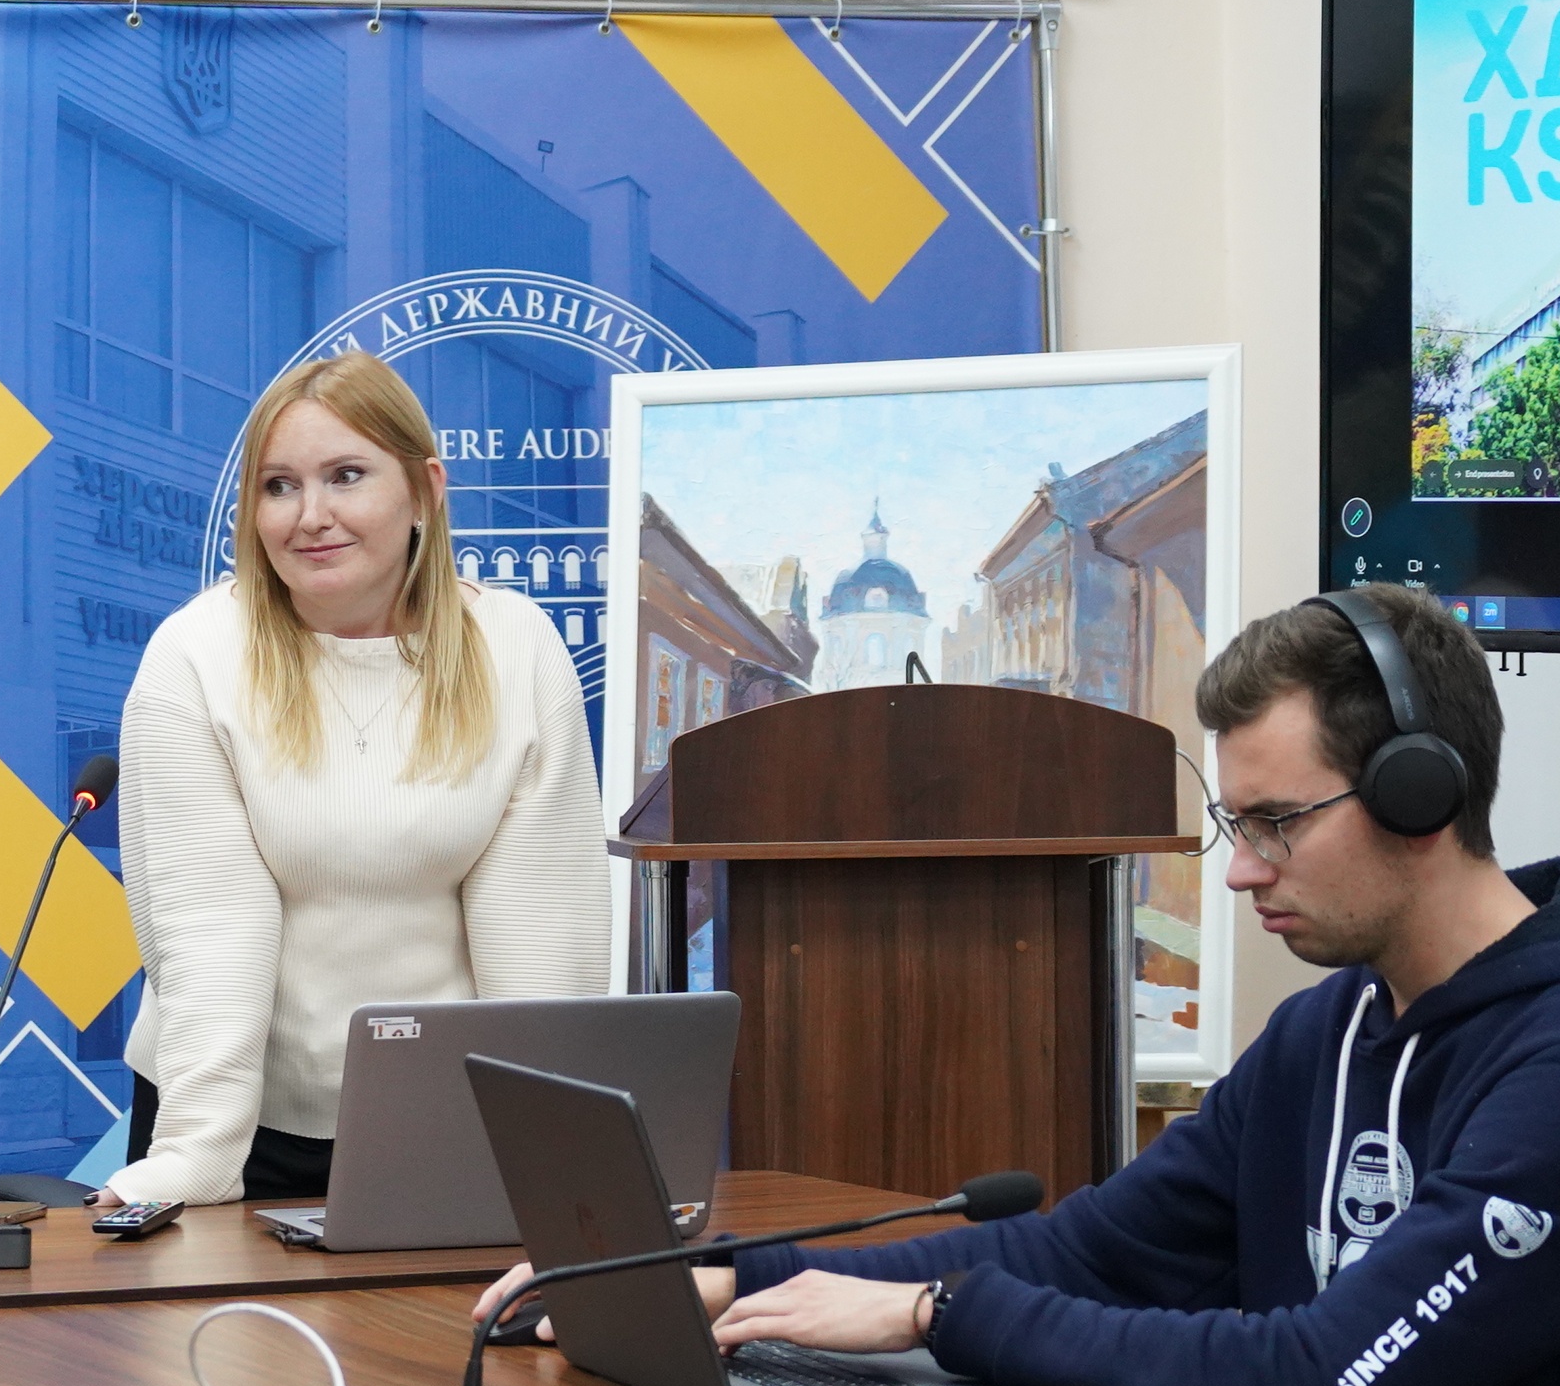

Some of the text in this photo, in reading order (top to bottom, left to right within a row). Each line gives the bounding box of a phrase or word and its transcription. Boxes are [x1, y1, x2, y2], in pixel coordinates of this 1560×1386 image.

[380, 285, 648, 361] ДЕРЖАВНИЙ
[1405, 578, 1425, 590] Video
[1415, 1253, 1479, 1322] 1917
